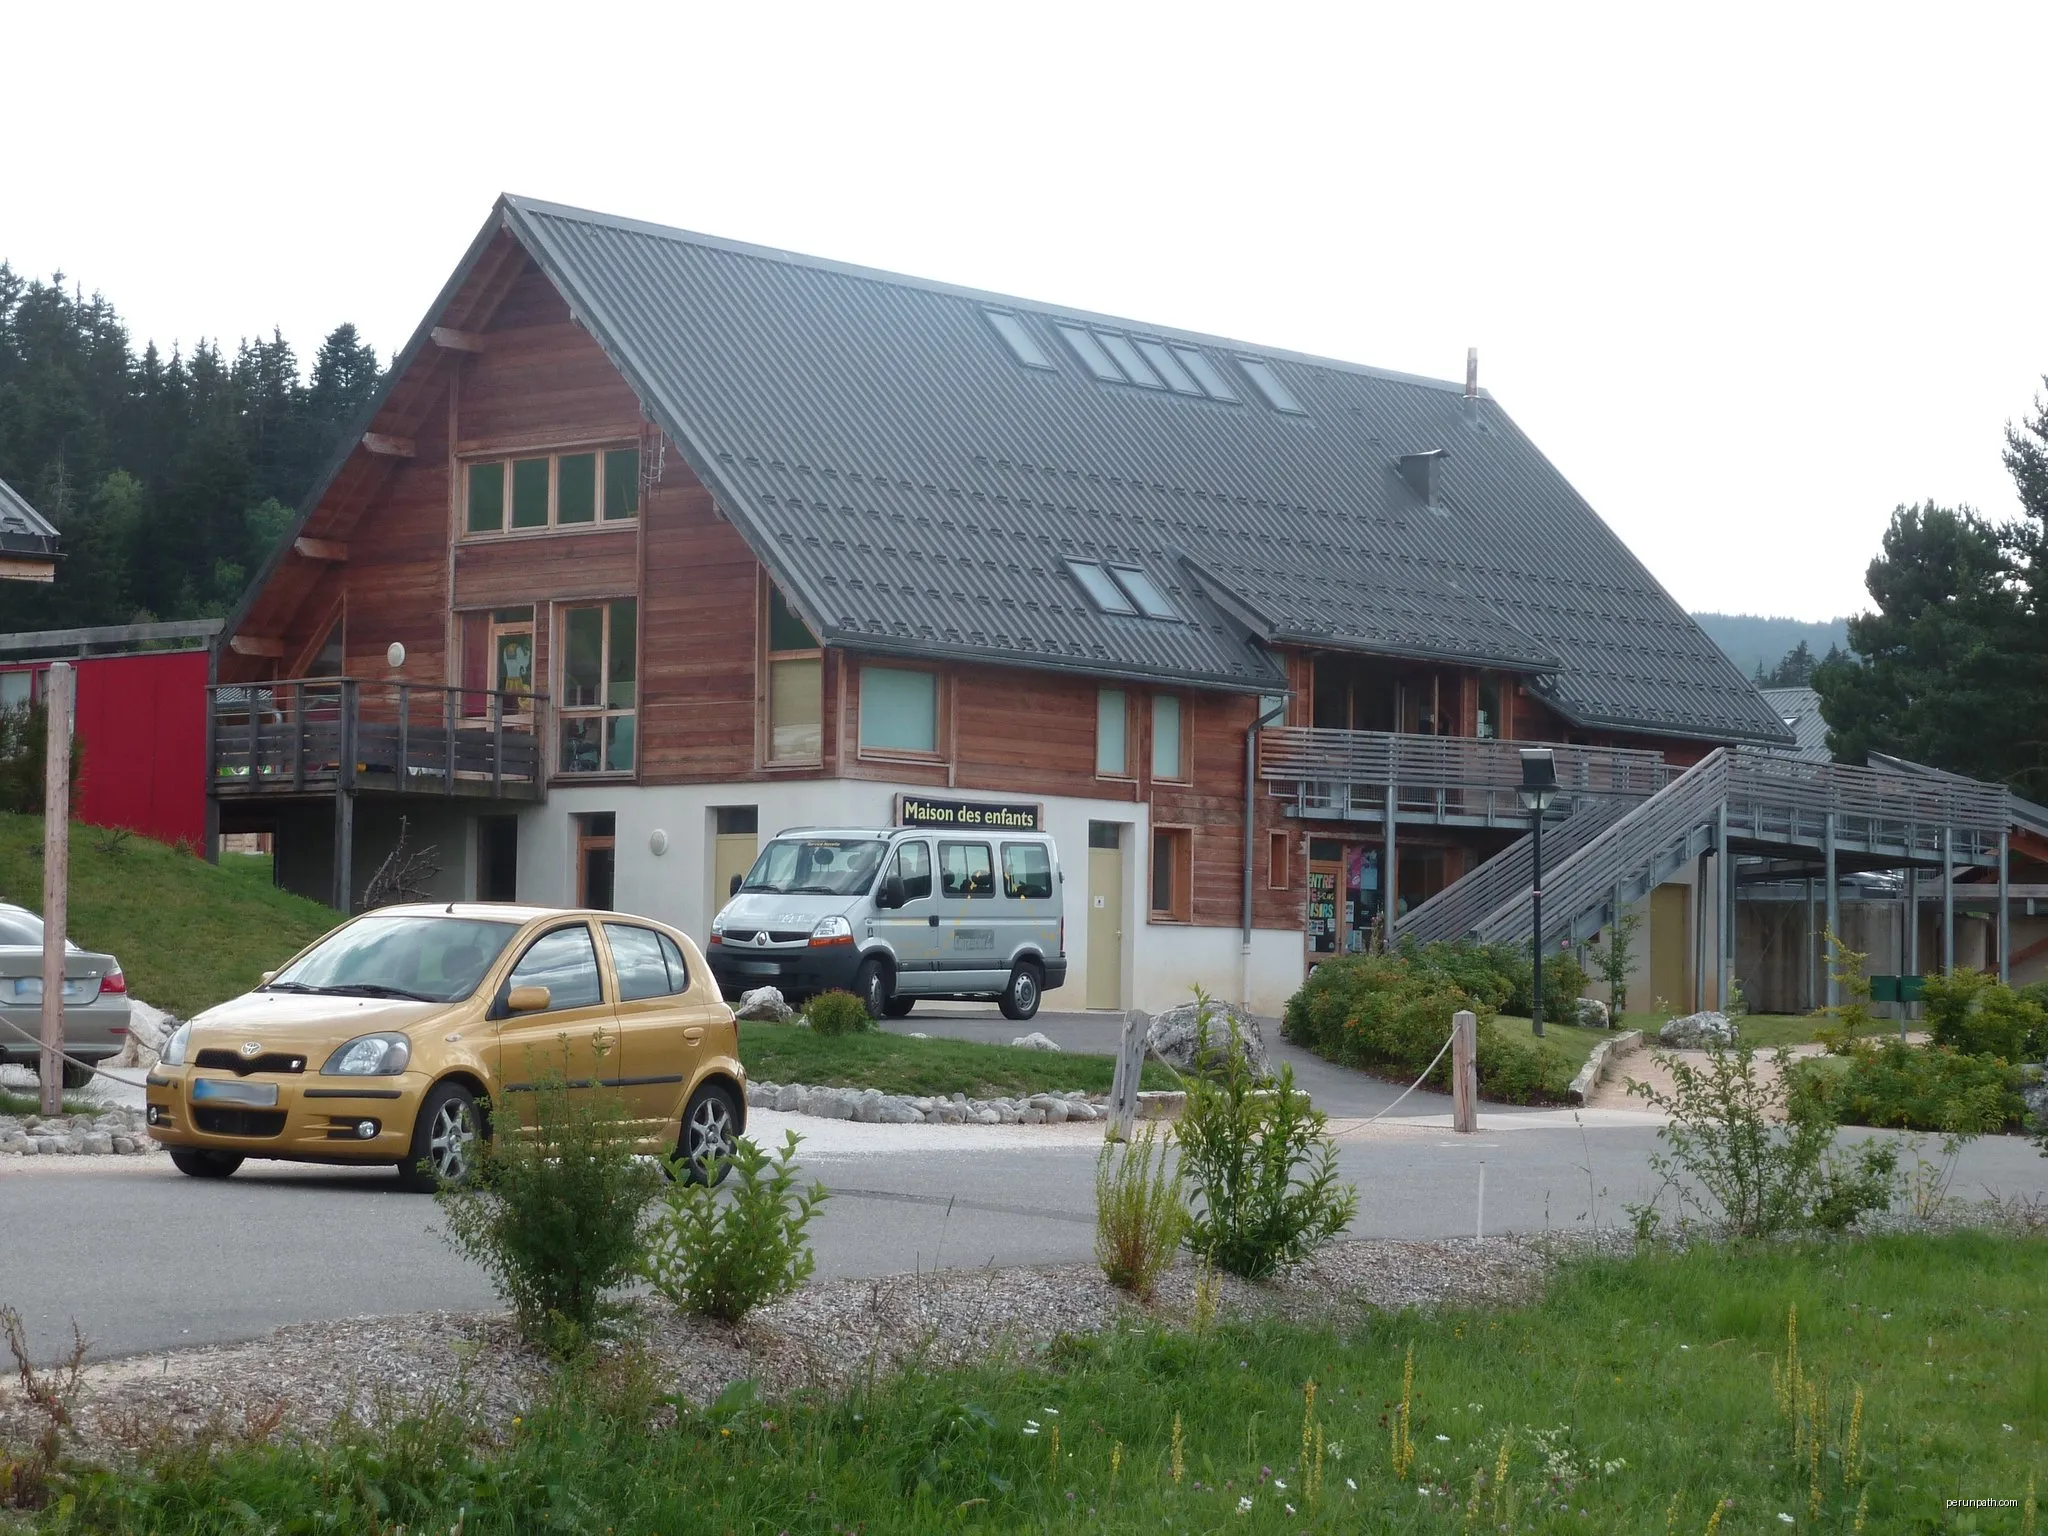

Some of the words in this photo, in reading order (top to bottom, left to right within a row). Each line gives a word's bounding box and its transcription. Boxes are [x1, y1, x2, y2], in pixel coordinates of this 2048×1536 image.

[905, 801, 954, 822] Maison
[957, 805, 981, 824] des
[984, 808, 1034, 827] enfants
[1309, 873, 1335, 888] ENTRE
